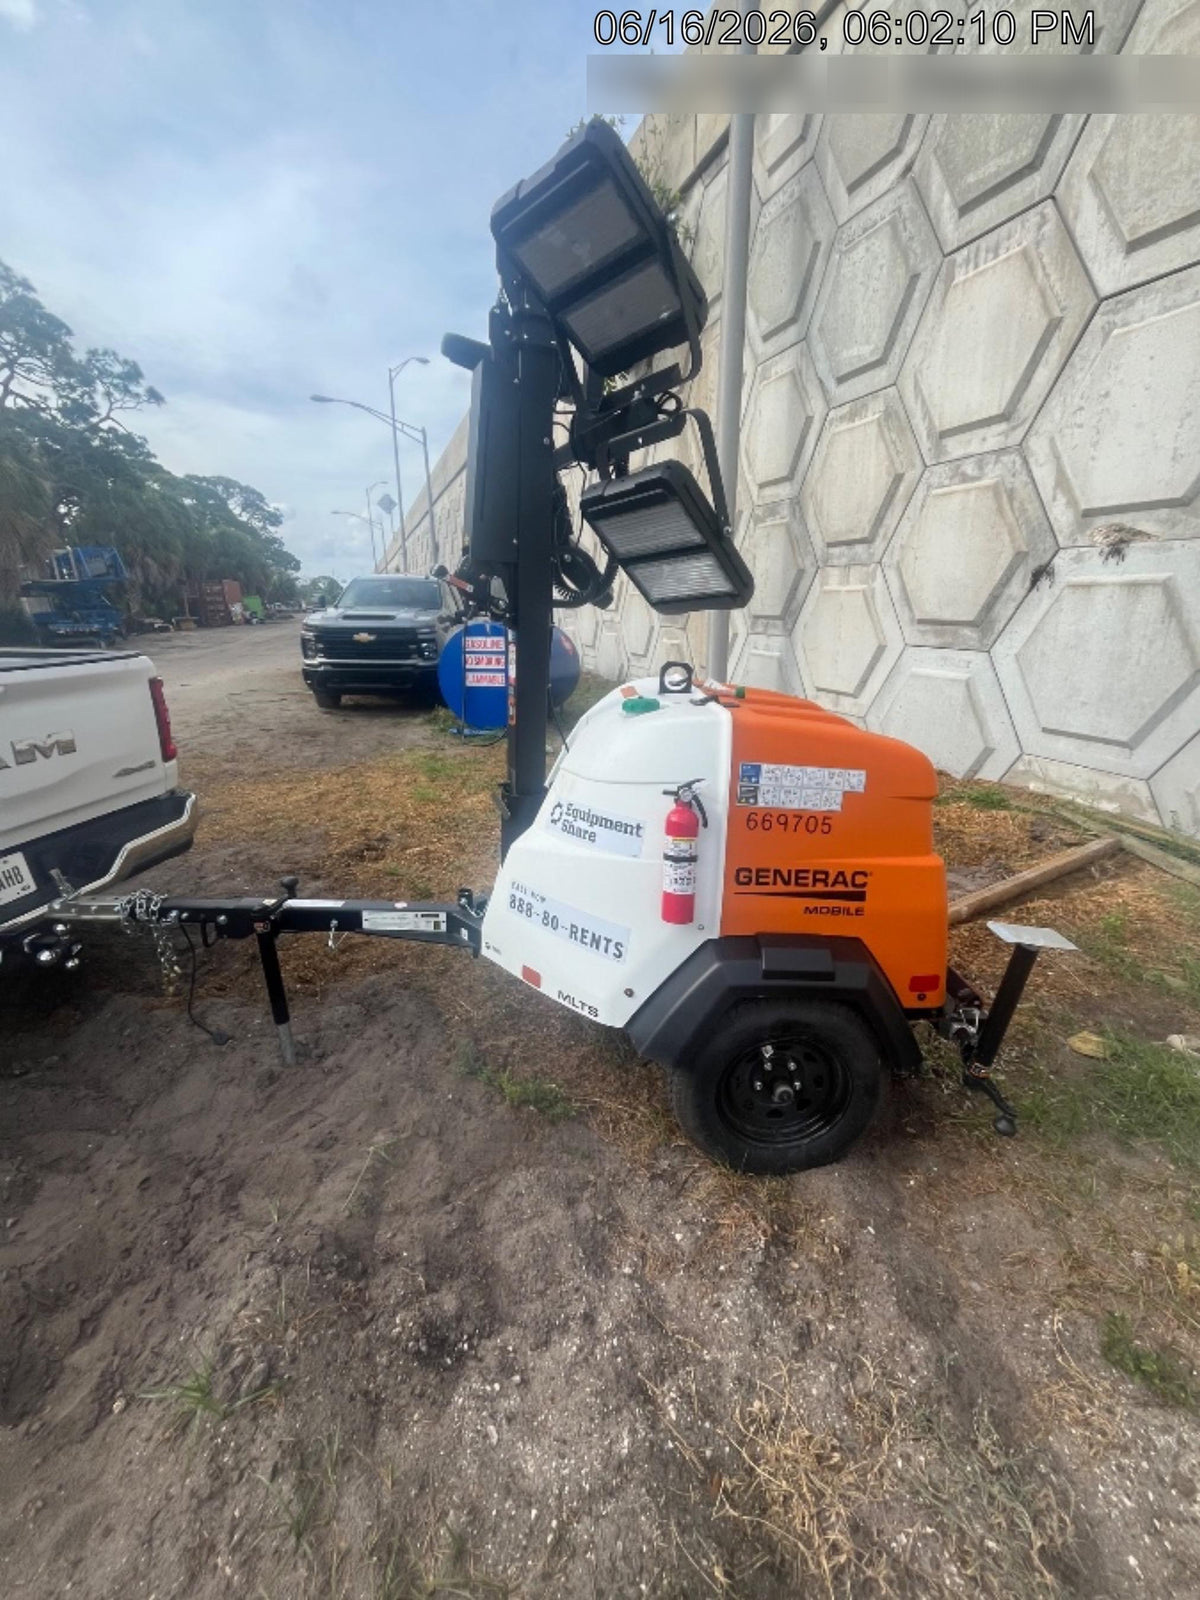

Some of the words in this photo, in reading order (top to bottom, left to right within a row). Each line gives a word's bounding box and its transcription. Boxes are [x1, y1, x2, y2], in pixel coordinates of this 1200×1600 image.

[560, 818, 597, 844] Share
[564, 802, 644, 839] Equipment
[746, 812, 833, 835] 669705
[735, 867, 869, 890] GENERAC
[803, 906, 865, 917] MOBILE
[509, 893, 625, 960] 888-80-RENTS
[557, 990, 599, 1018] MLTS
